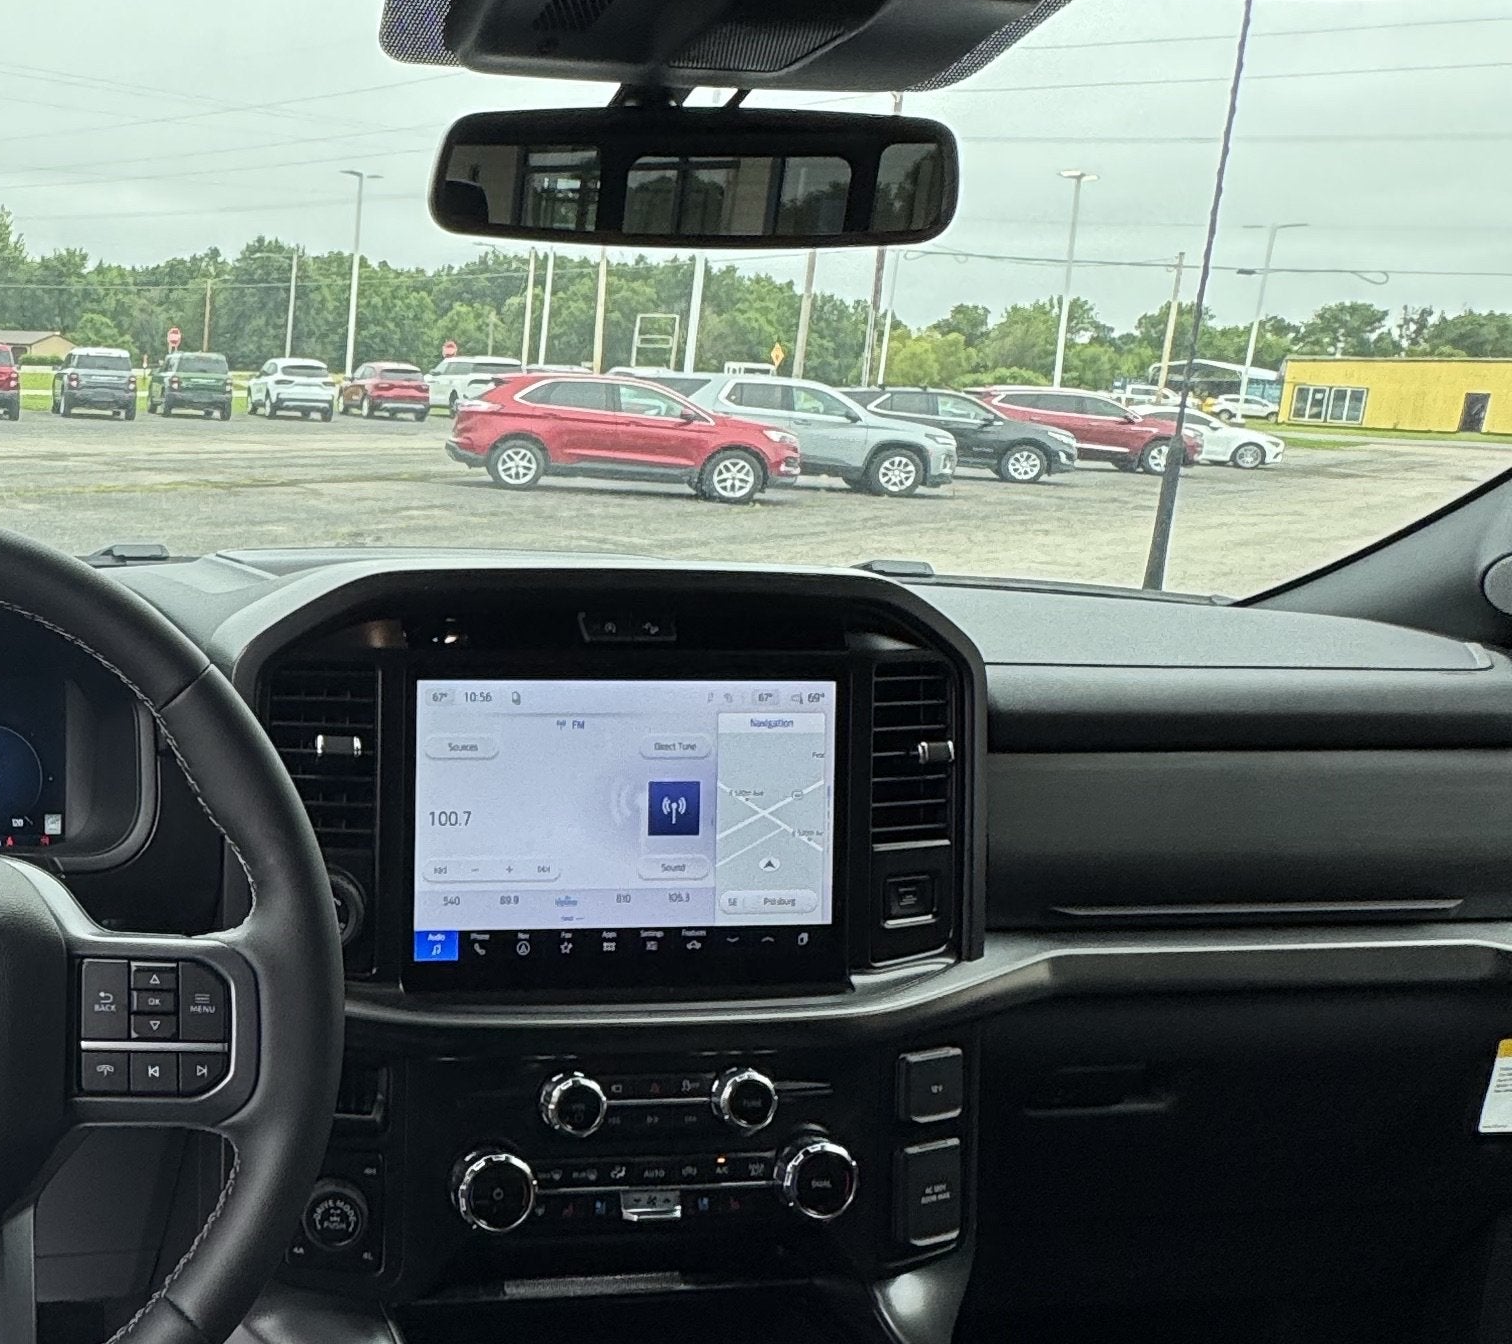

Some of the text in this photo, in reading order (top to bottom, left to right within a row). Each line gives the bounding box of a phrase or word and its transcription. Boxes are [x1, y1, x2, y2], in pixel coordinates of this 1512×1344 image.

[464, 691, 493, 703] 10:56
[572, 719, 585, 730] FM
[750, 718, 794, 729] Navigation
[448, 741, 479, 752] Sources
[654, 742, 697, 751] Direct Tune
[428, 810, 472, 827] 100.7
[661, 863, 686, 873] Sound
[428, 933, 446, 942] Audio
[602, 930, 617, 939] Apps
[148, 997, 162, 1006] OK
[94, 1003, 117, 1013] BACK
[189, 1005, 216, 1014] MENU
[643, 1169, 666, 1178] AUTO
